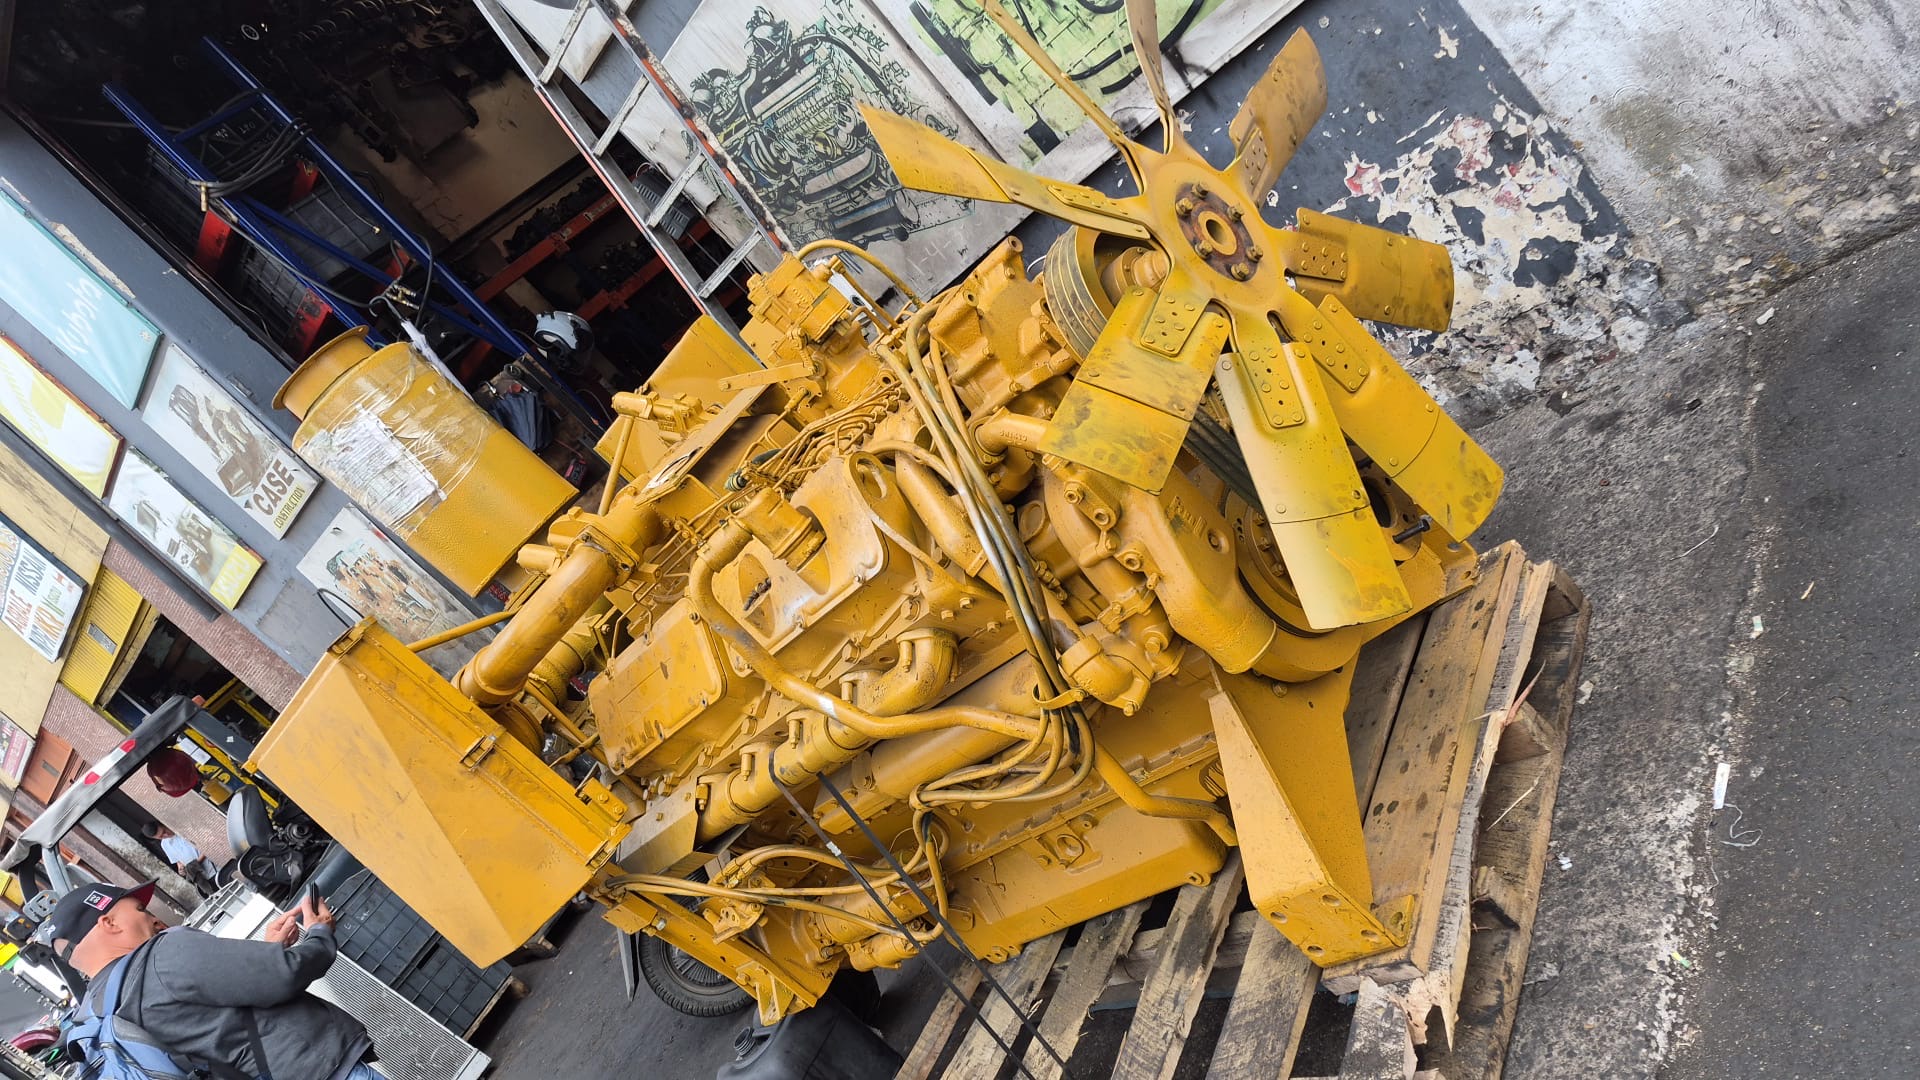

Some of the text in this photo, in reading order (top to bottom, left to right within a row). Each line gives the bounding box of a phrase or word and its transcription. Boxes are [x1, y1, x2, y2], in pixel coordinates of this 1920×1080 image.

[55, 277, 103, 355] Kubota
[252, 458, 295, 516] CASE
[14, 547, 47, 596] NISSAN
